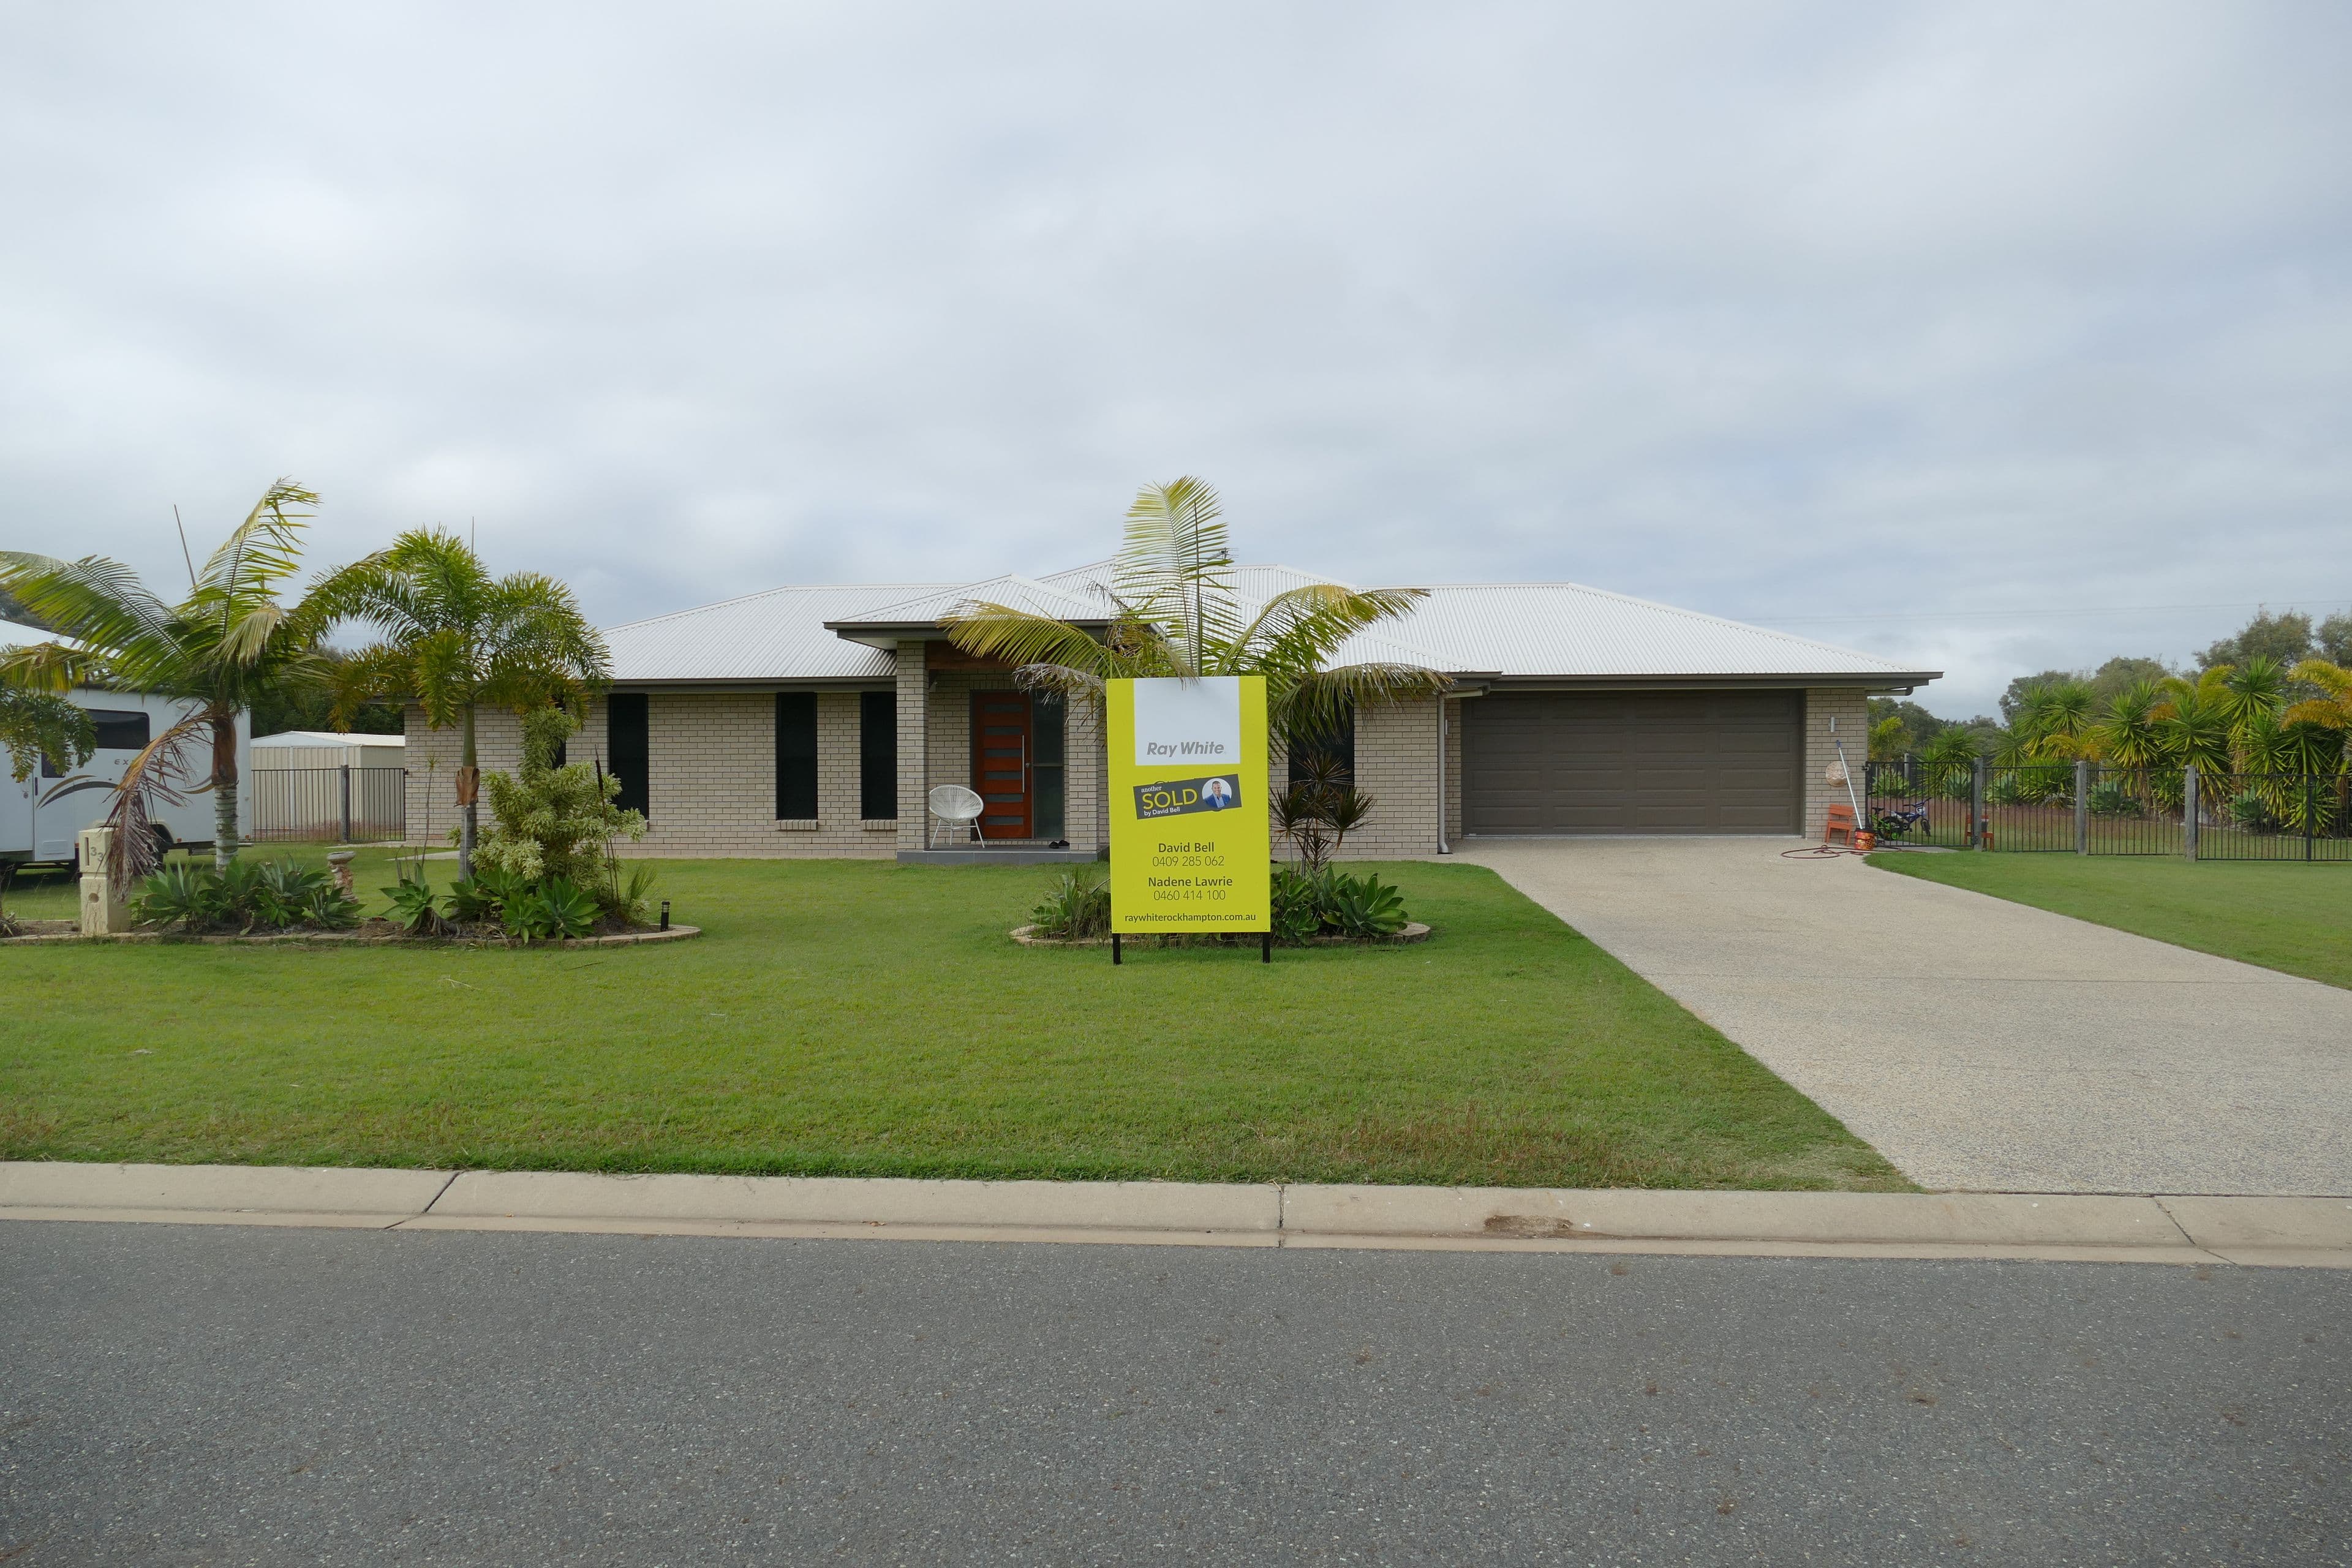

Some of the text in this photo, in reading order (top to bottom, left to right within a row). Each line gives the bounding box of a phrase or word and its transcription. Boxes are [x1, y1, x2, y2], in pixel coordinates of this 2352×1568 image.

[1147, 741, 1224, 758] Ray White
[1142, 789, 1199, 810] SOLD
[1158, 842, 1214, 852] David Bell
[1152, 856, 1225, 867] 0409 285 062
[1148, 876, 1233, 886] Nadene Lawrie
[1153, 890, 1226, 900] 0460 414 100
[1125, 913, 1256, 923] raywhiterockhampton.com.au
